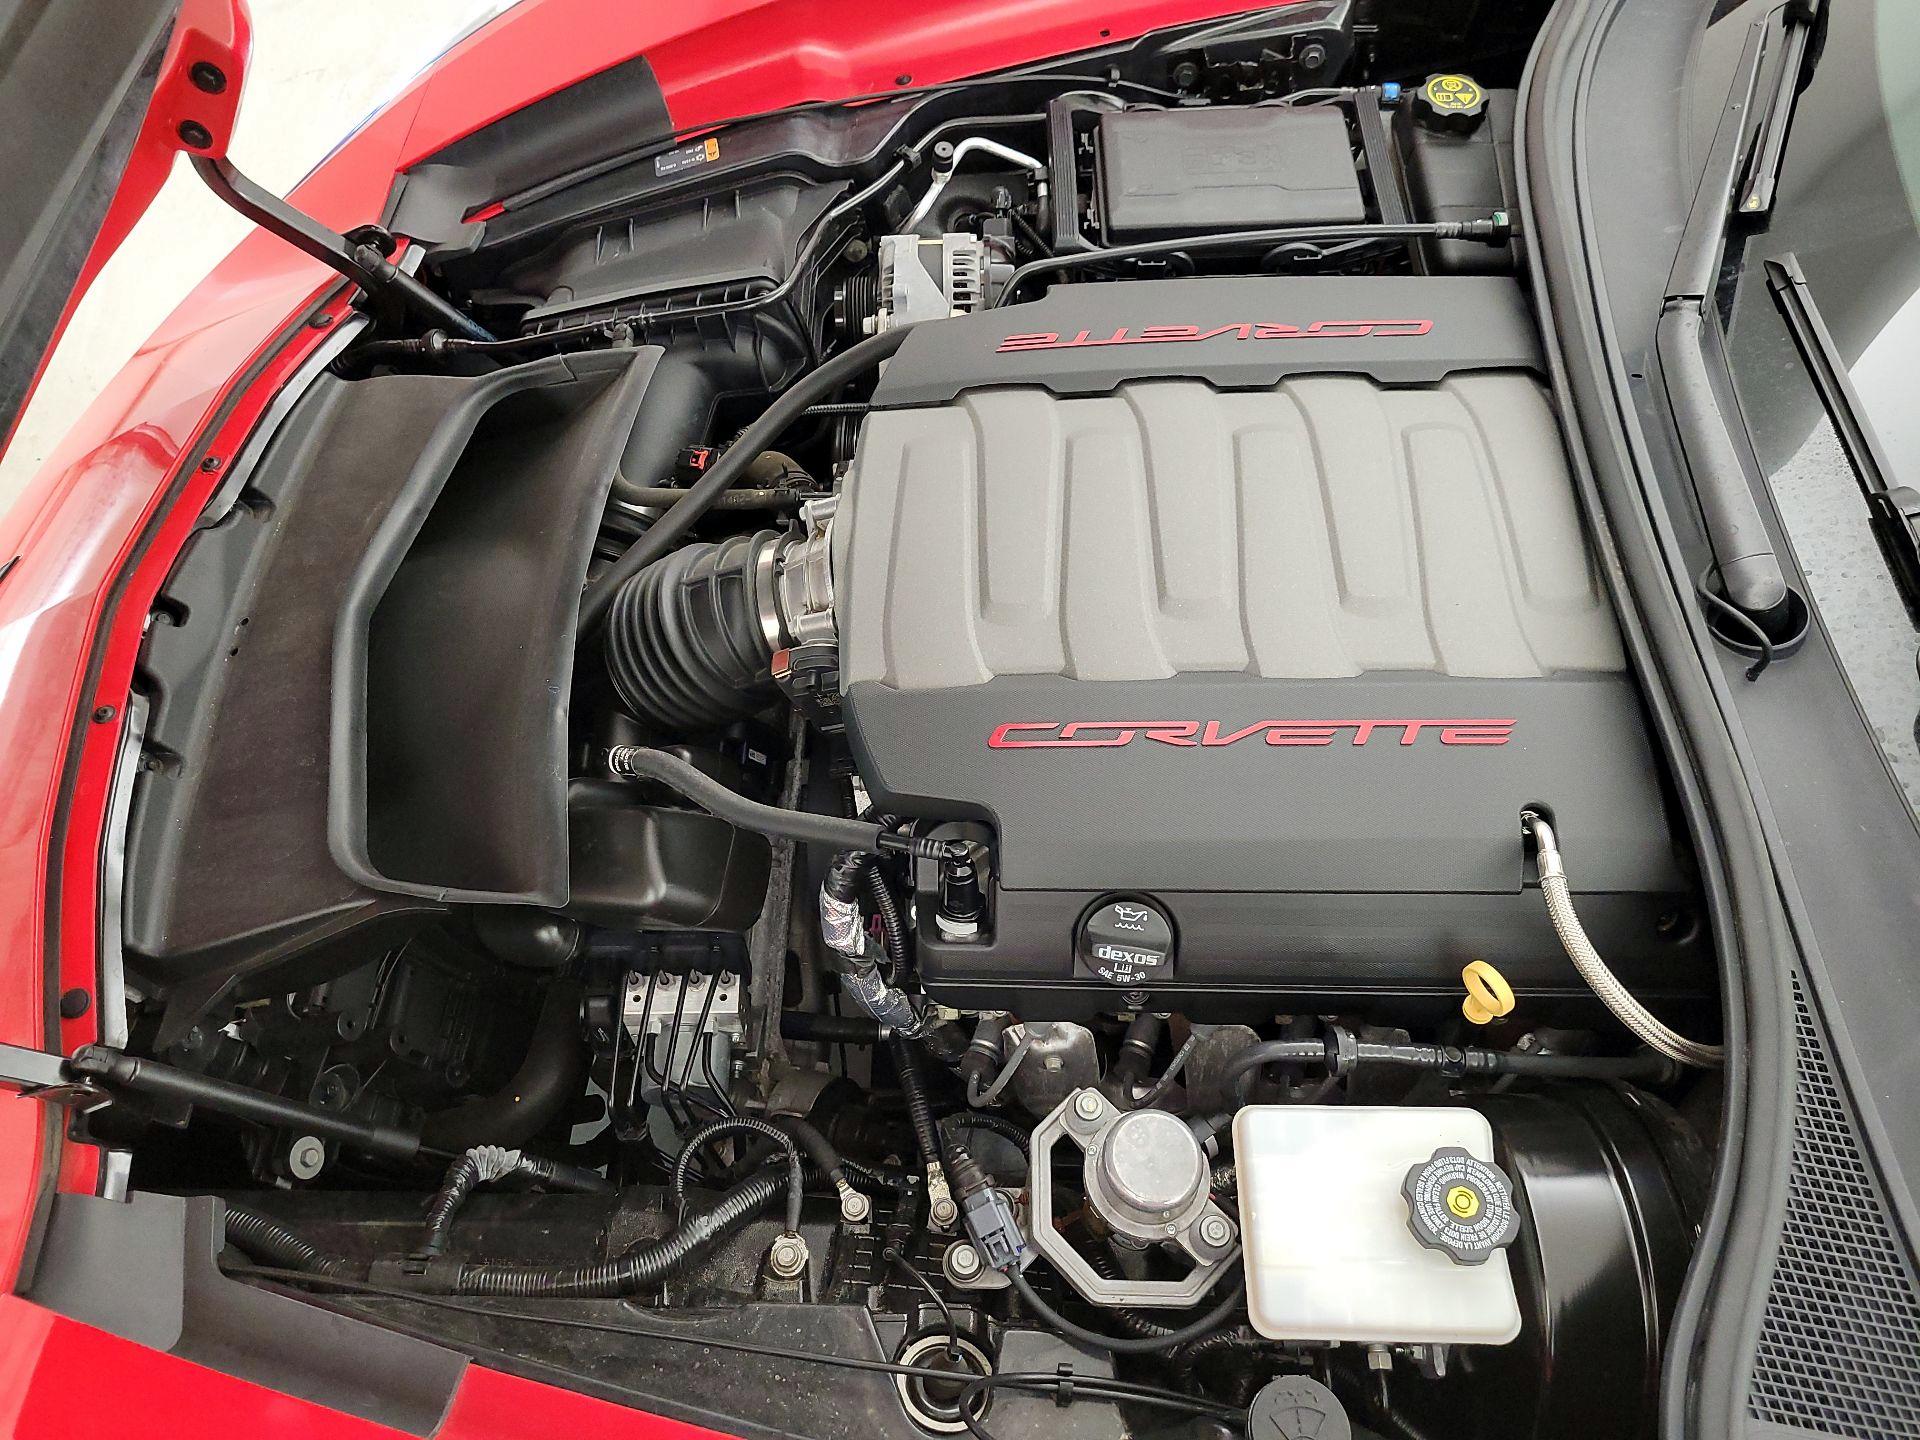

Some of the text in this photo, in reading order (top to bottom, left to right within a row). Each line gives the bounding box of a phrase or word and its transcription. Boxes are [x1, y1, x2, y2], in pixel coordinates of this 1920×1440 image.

[996, 319, 1433, 353] CORVETTE
[988, 719, 1516, 749] CORVETTE
[1098, 945, 1160, 966] dexos
[1098, 966, 1114, 980] SAE
[1116, 971, 1146, 983] 5W-30
[1502, 1210, 1509, 1220] LE
